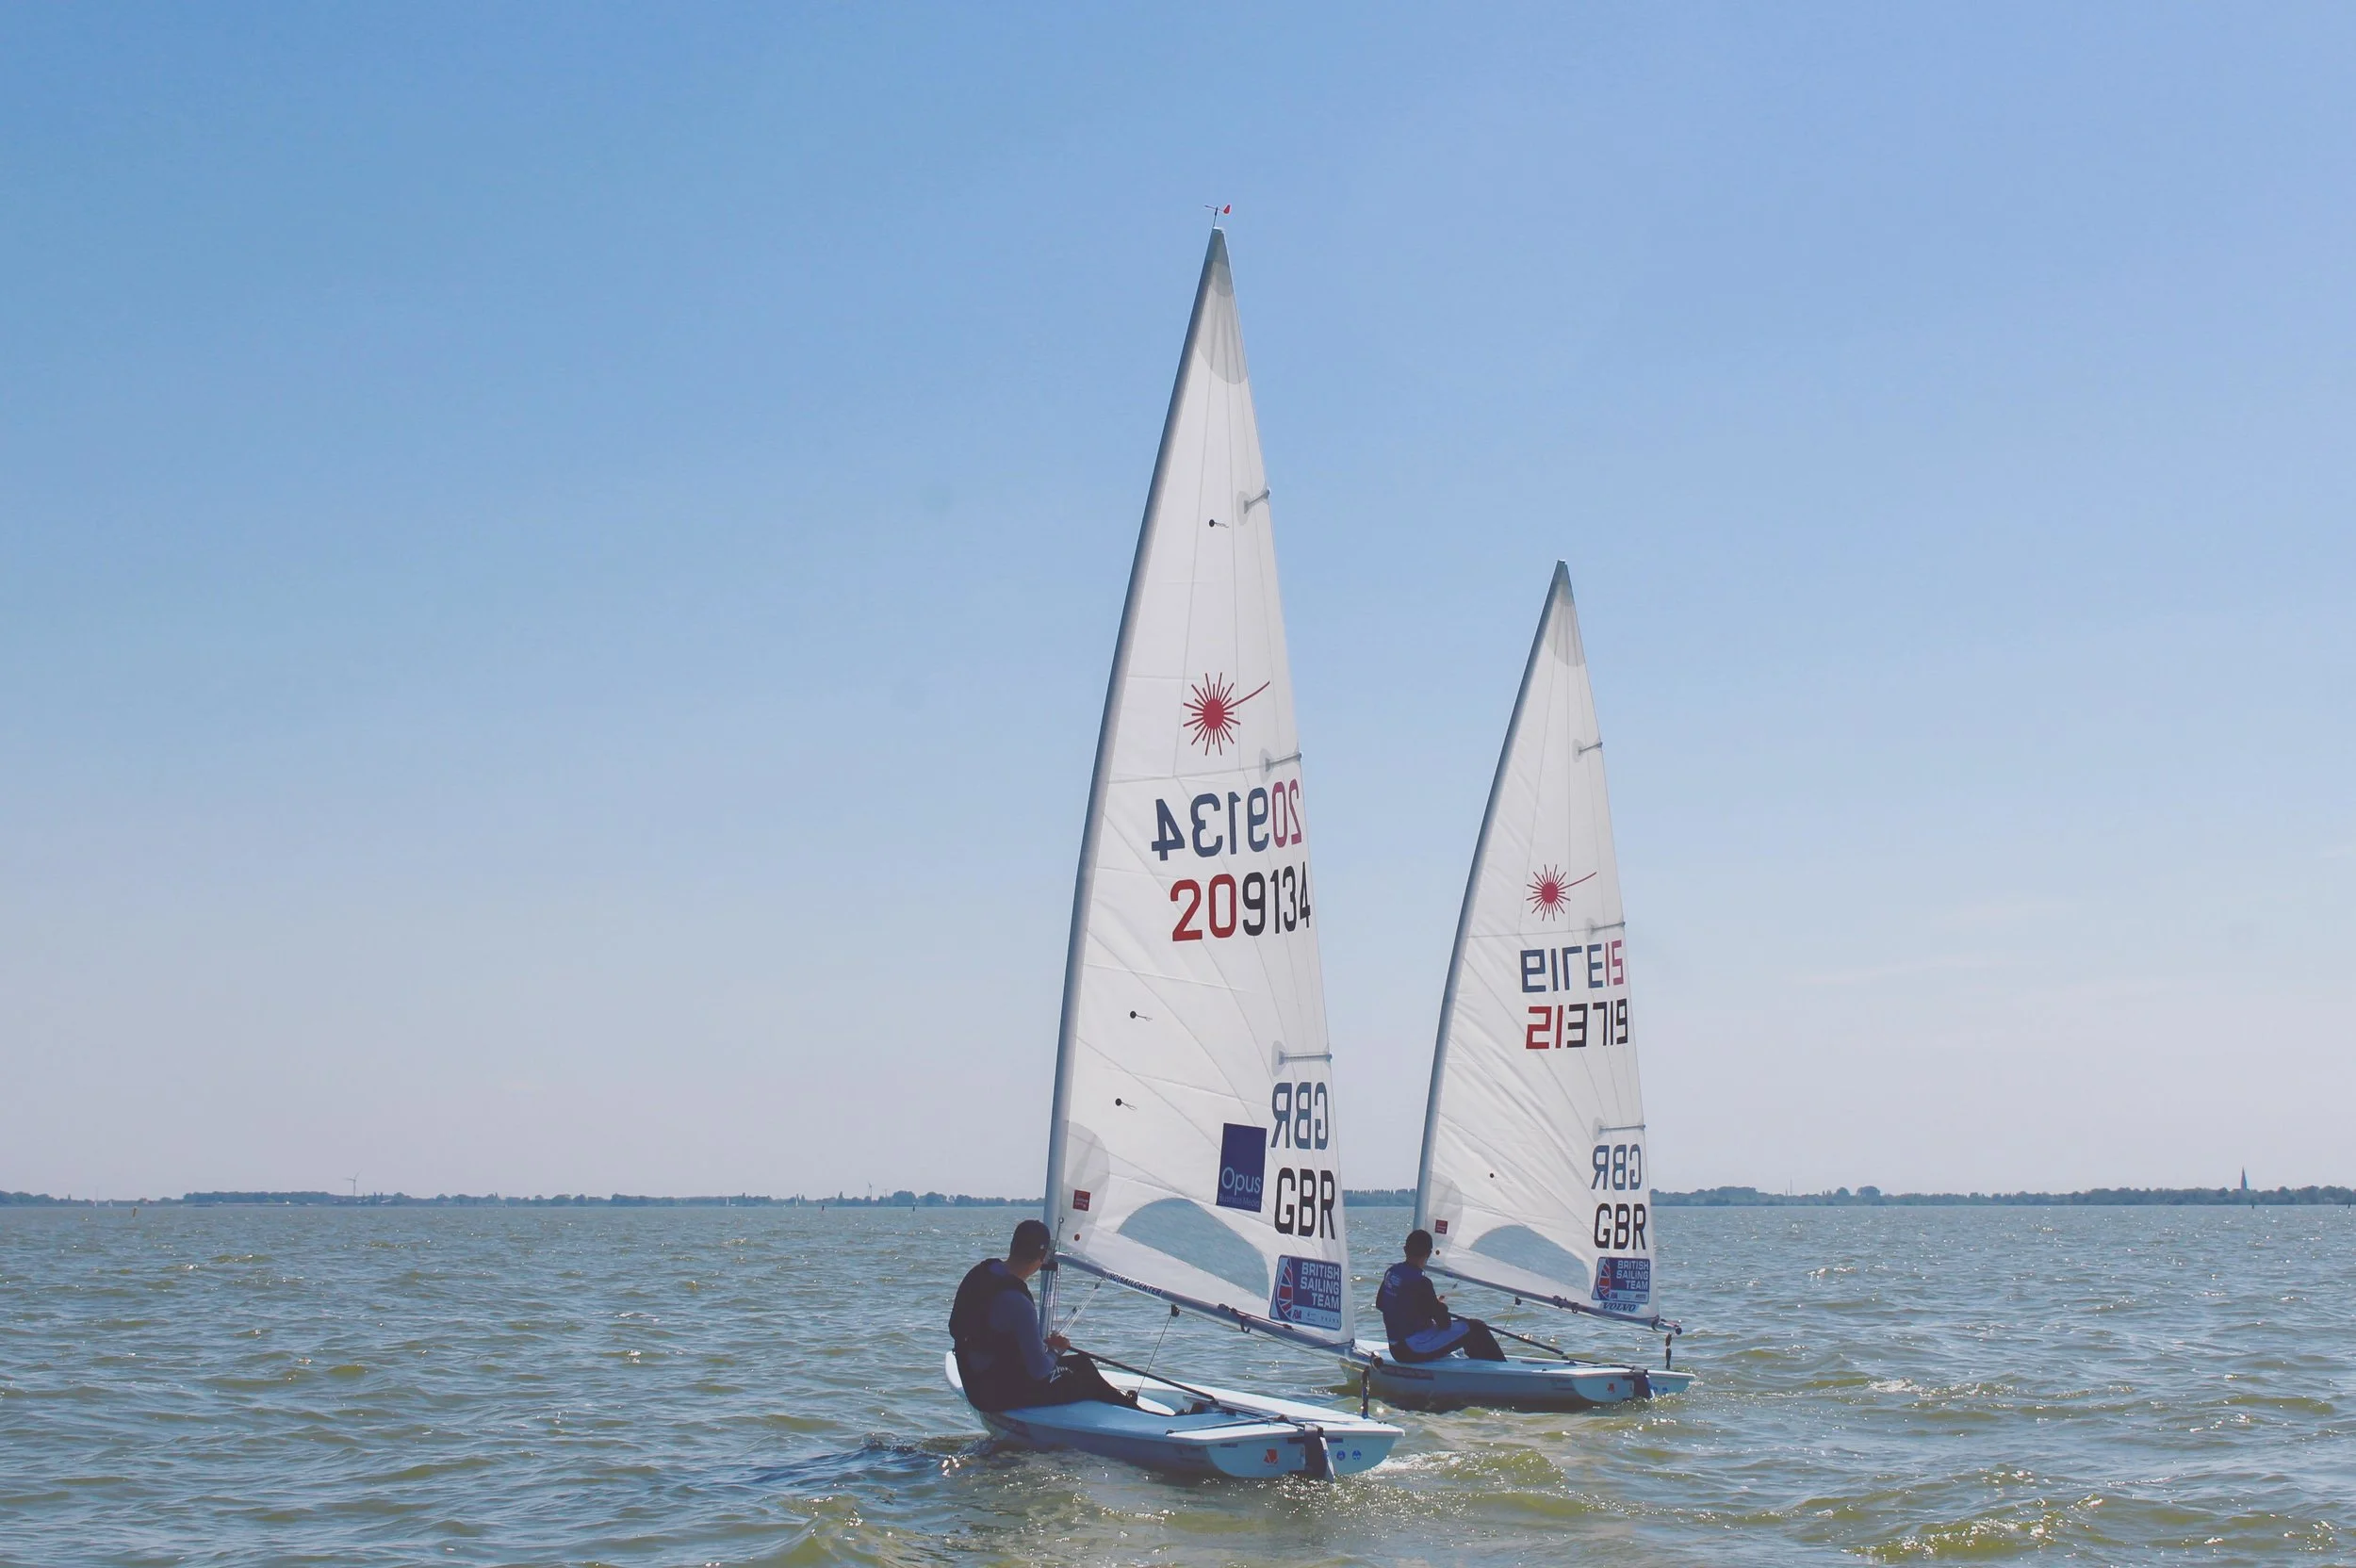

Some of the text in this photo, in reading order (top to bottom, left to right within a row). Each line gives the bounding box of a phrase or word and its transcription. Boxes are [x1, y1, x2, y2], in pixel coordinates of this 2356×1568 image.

[1169, 860, 1312, 942] 209134
[1524, 997, 1629, 1051] 213719
[1221, 1167, 1261, 1197] Opus
[1274, 1167, 1337, 1241] GBR
[1594, 1202, 1647, 1251] GBR
[1301, 1261, 1340, 1281] BRITISH
[1615, 1269, 1649, 1281] SAILING
[1617, 1260, 1649, 1270] BRITISH
[1300, 1276, 1340, 1296] SAILING
[1625, 1280, 1648, 1290] TEAM
[1311, 1292, 1340, 1310] TEAM
[1601, 1301, 1637, 1313] VOLVO
